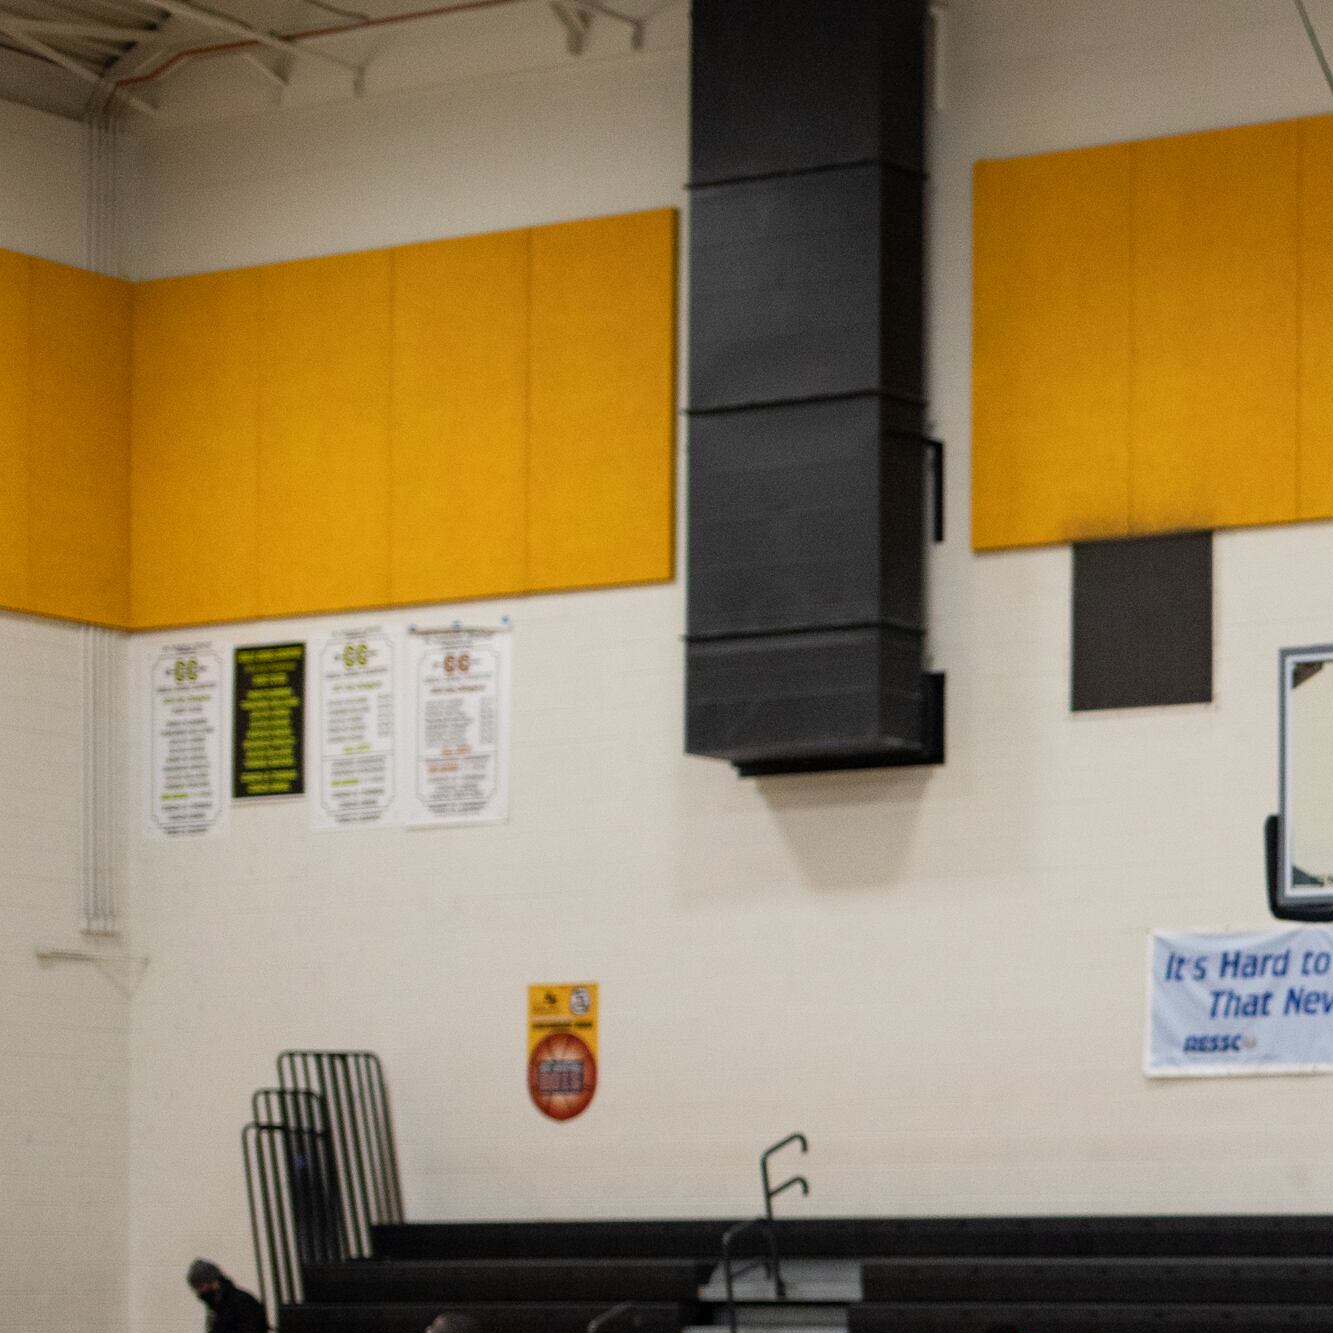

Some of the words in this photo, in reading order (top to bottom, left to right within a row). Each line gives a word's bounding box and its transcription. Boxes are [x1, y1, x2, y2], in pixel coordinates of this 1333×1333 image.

[1165, 951, 1206, 982] It's
[1219, 948, 1291, 979] Hard
[1301, 950, 1330, 976] to
[1208, 989, 1272, 1019] That
